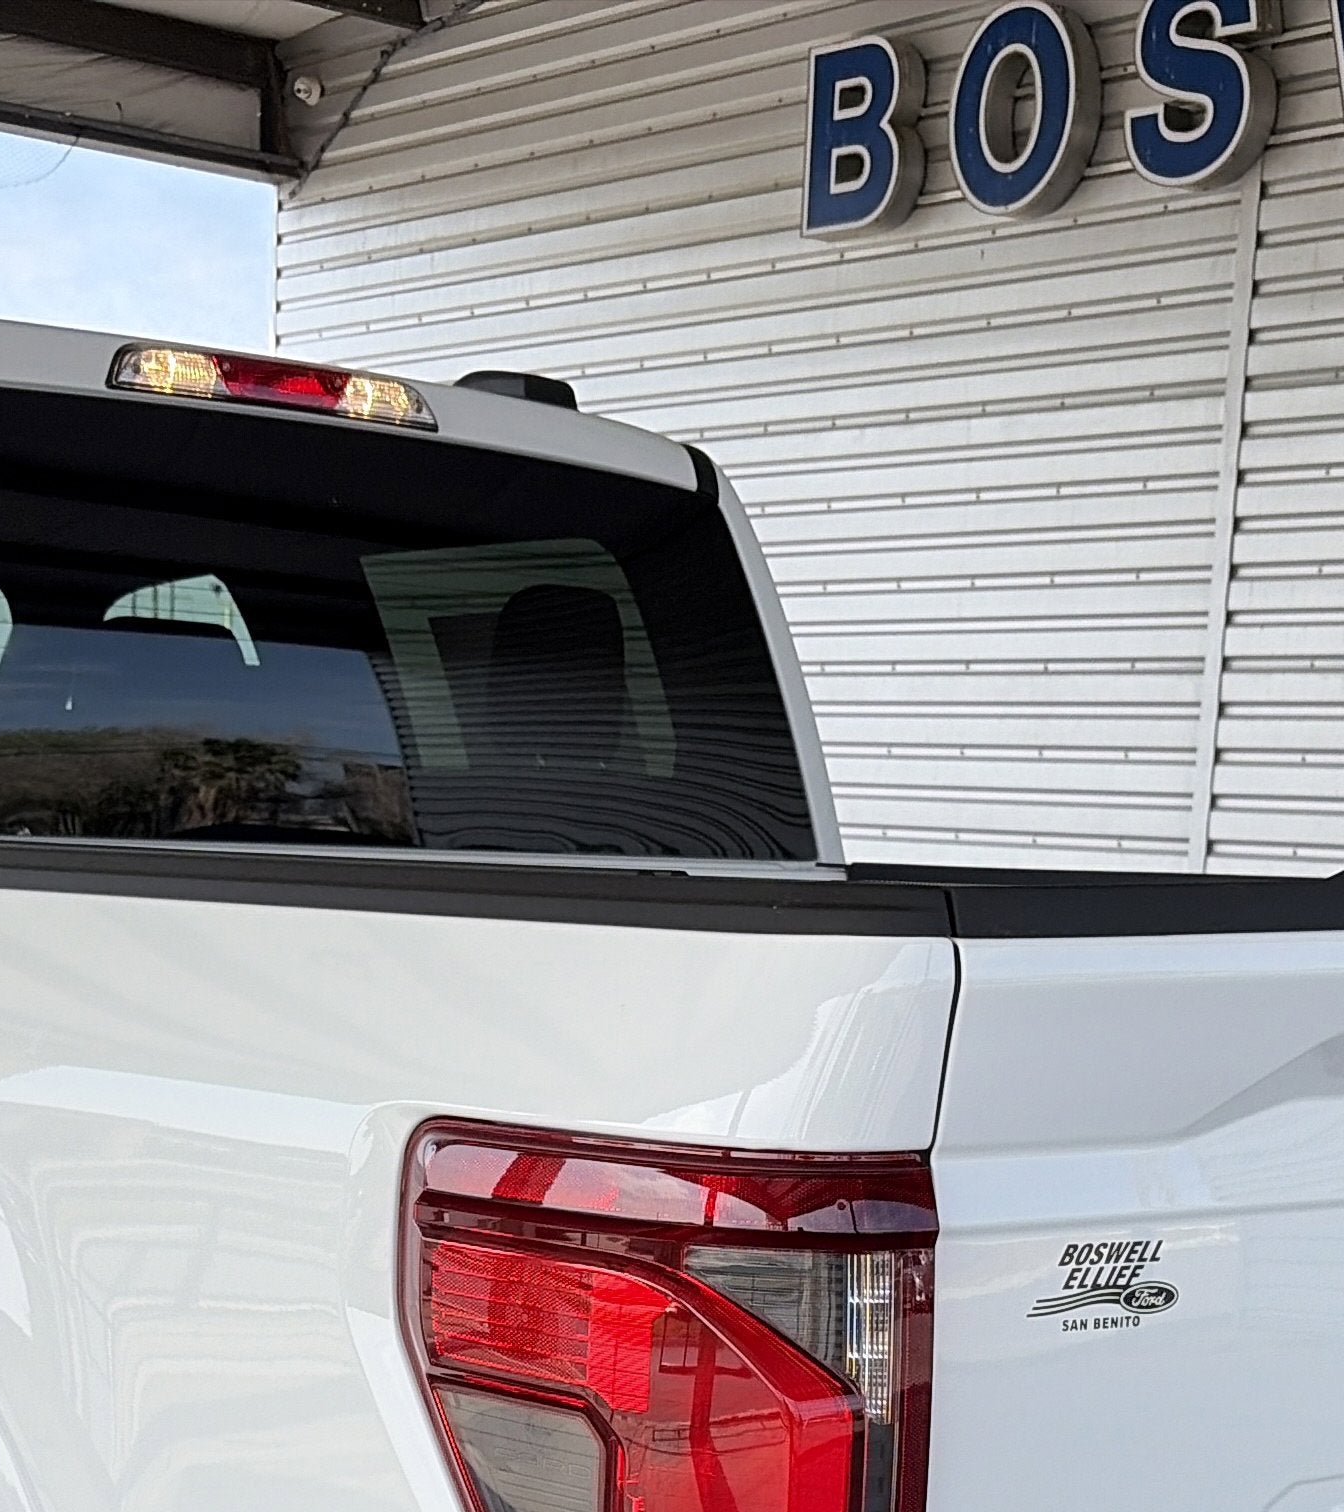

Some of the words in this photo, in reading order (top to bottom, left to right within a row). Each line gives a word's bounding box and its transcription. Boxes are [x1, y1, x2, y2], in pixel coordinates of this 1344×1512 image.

[1057, 1239, 1164, 1267] BOSWELL
[1062, 1264, 1145, 1290] ELLIFF
[1131, 1288, 1167, 1307] Ford
[1062, 1318, 1089, 1332] SAN
[1093, 1315, 1141, 1330] BENITO
